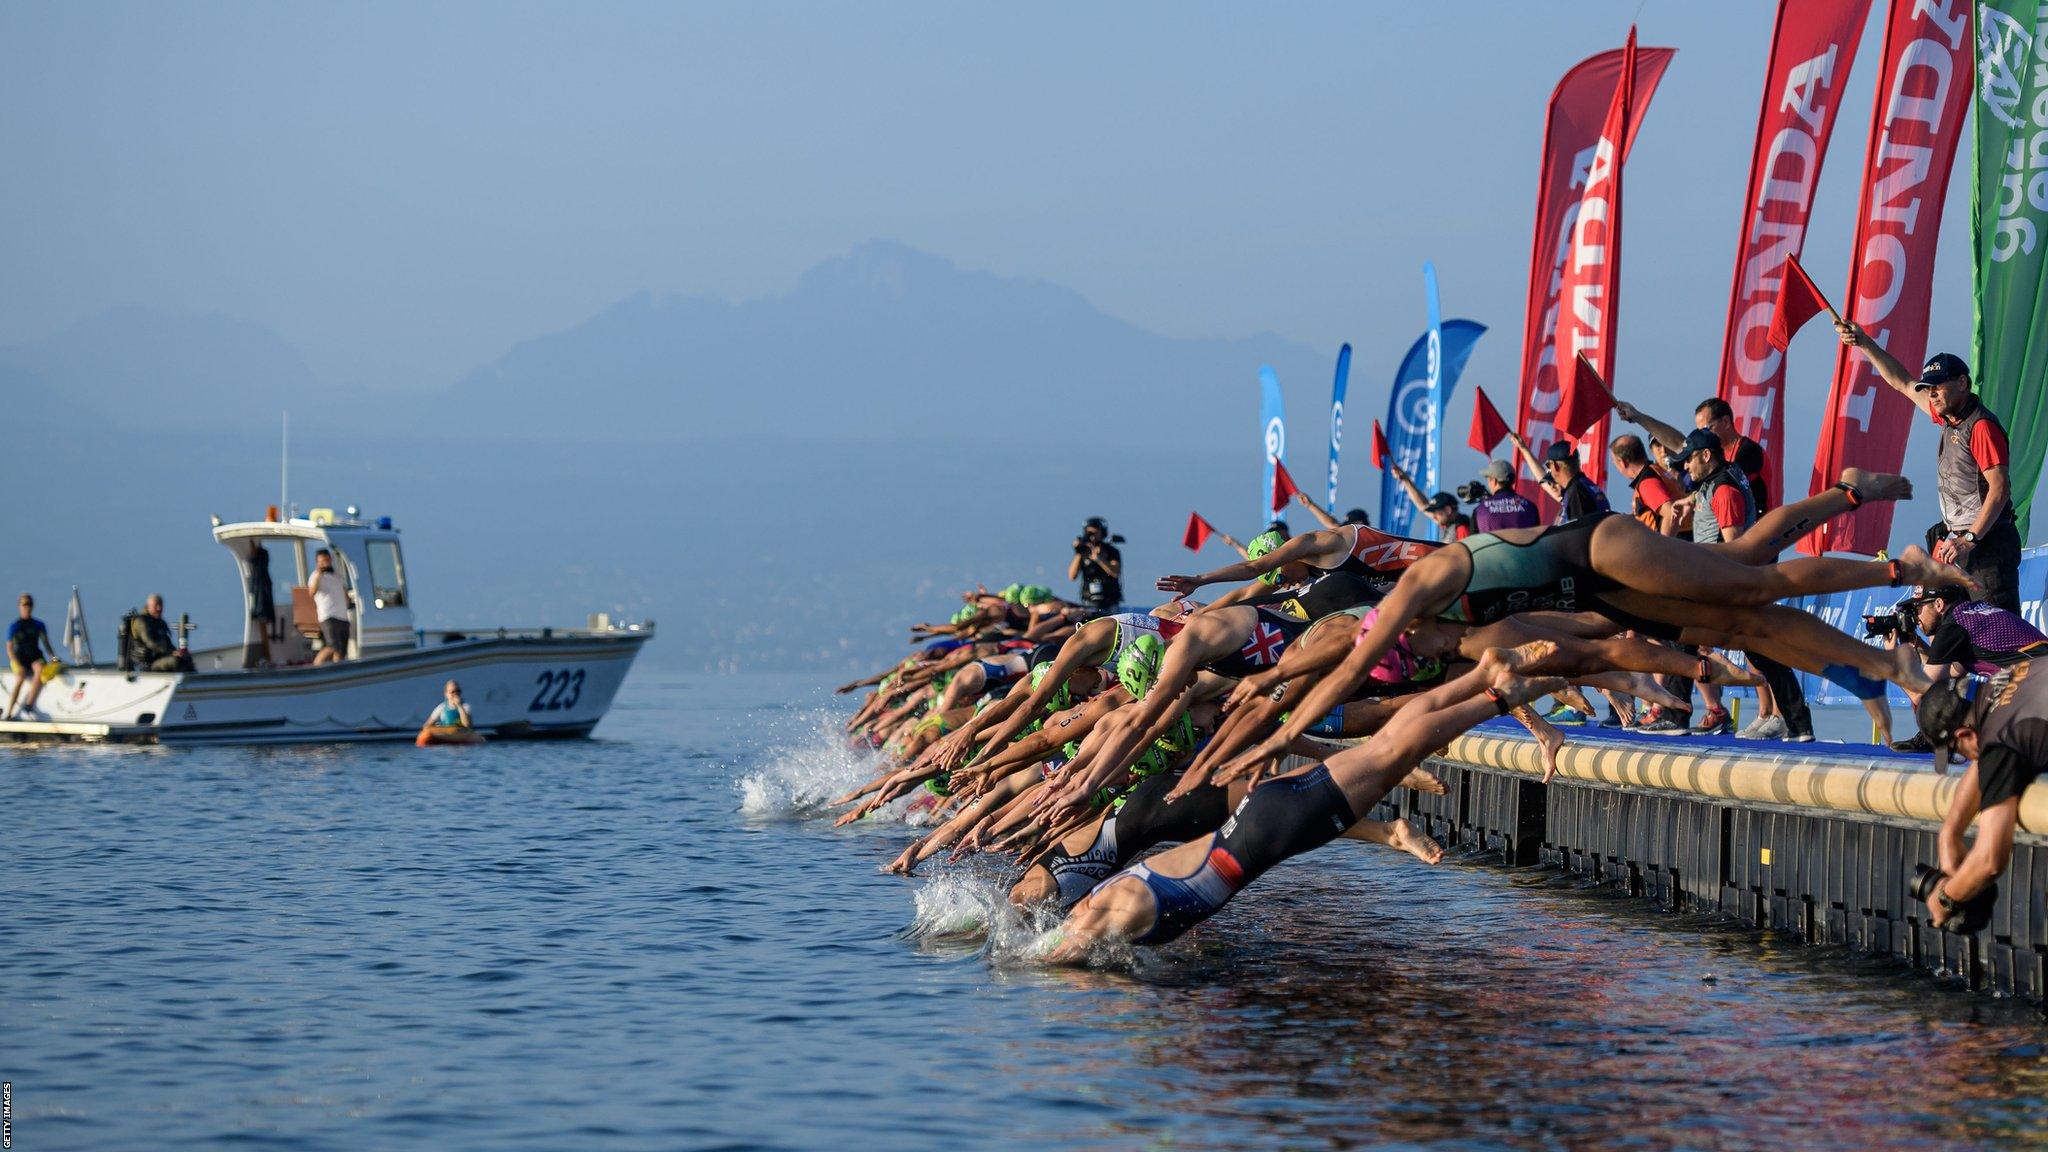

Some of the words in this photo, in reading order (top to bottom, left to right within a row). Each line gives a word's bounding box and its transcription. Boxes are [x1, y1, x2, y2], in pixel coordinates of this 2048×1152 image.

[1490, 504, 1526, 513] MEDIA
[1359, 541, 1419, 567] CZE
[528, 669, 586, 712] 223
